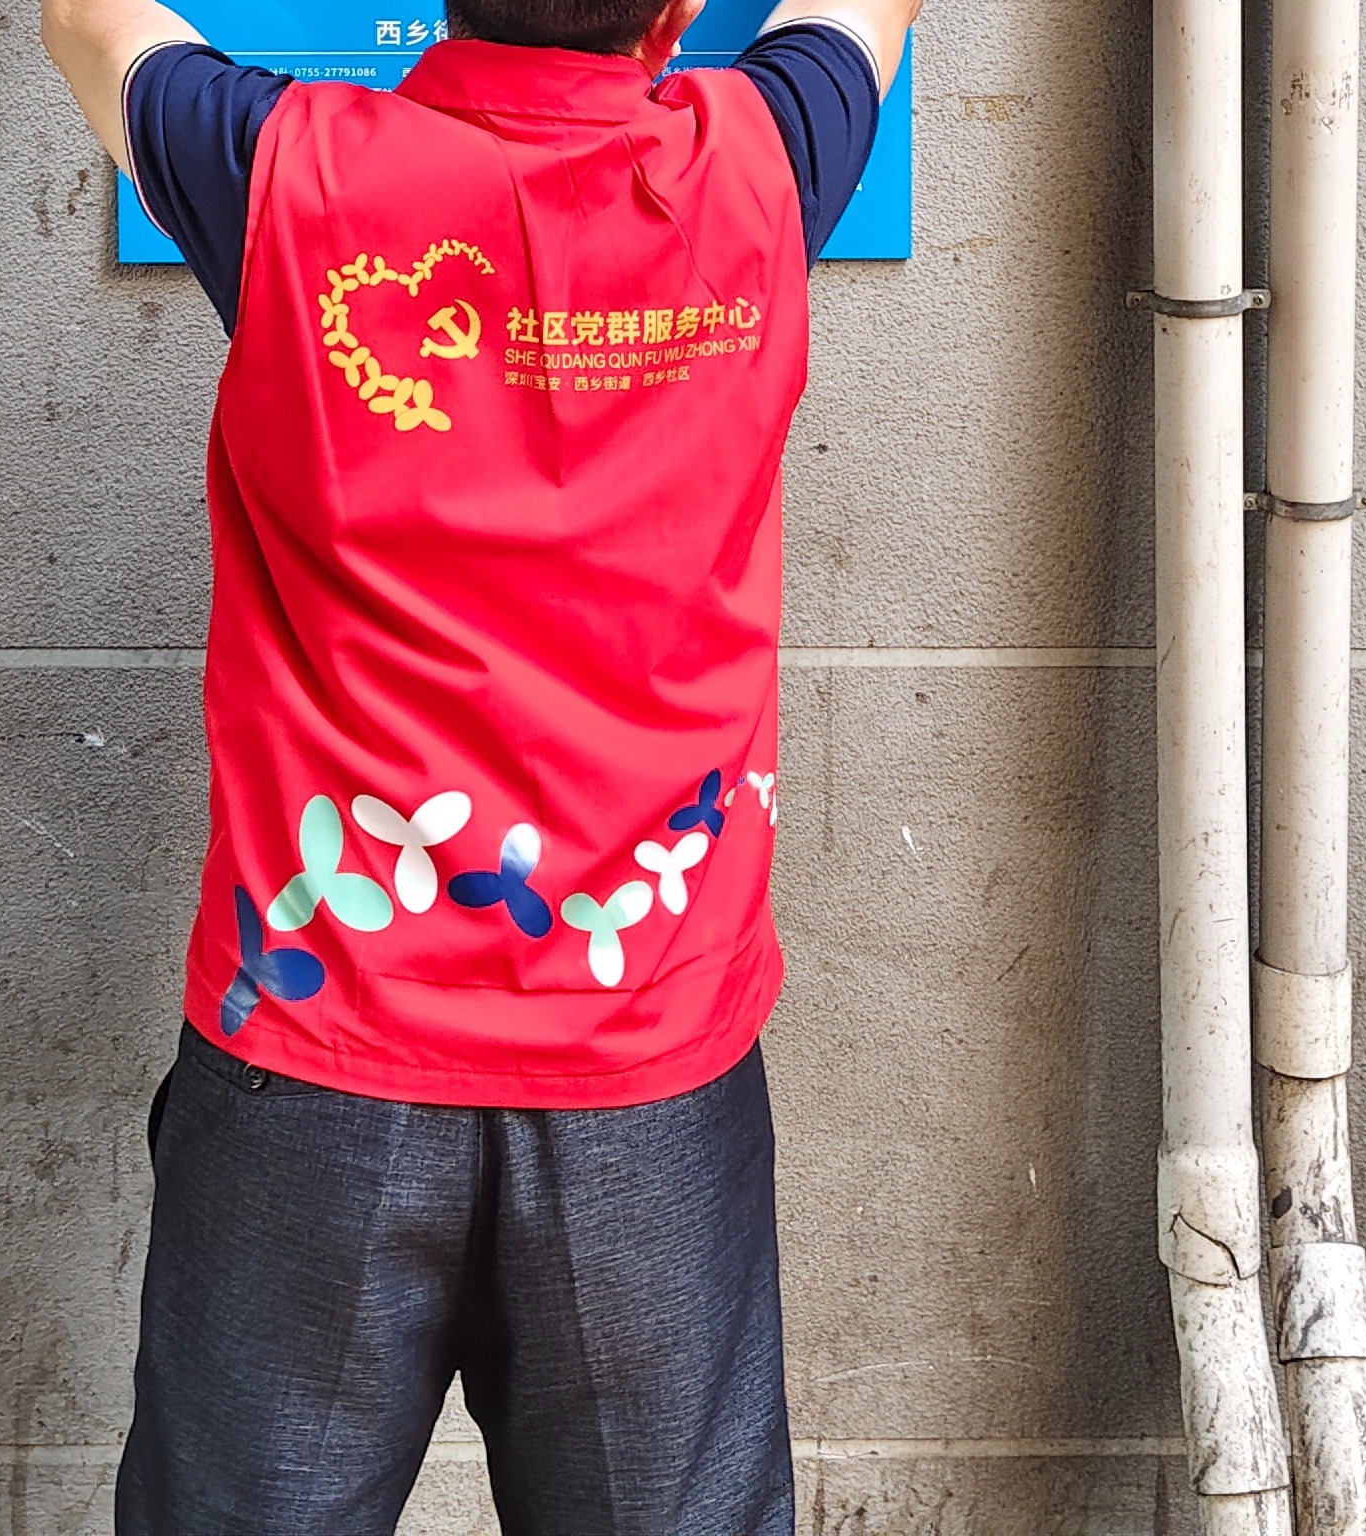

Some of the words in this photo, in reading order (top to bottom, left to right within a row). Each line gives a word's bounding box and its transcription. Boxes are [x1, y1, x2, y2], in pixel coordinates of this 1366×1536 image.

[505, 296, 762, 346] 社区党群服务中心
[504, 348, 537, 367] SHE
[540, 353, 560, 369] QU
[562, 353, 606, 369] DANG
[608, 352, 643, 369] QUN
[645, 350, 662, 366] FU
[664, 346, 684, 363] WU
[685, 339, 736, 359] ZHONG
[737, 335, 762, 352] XIN
